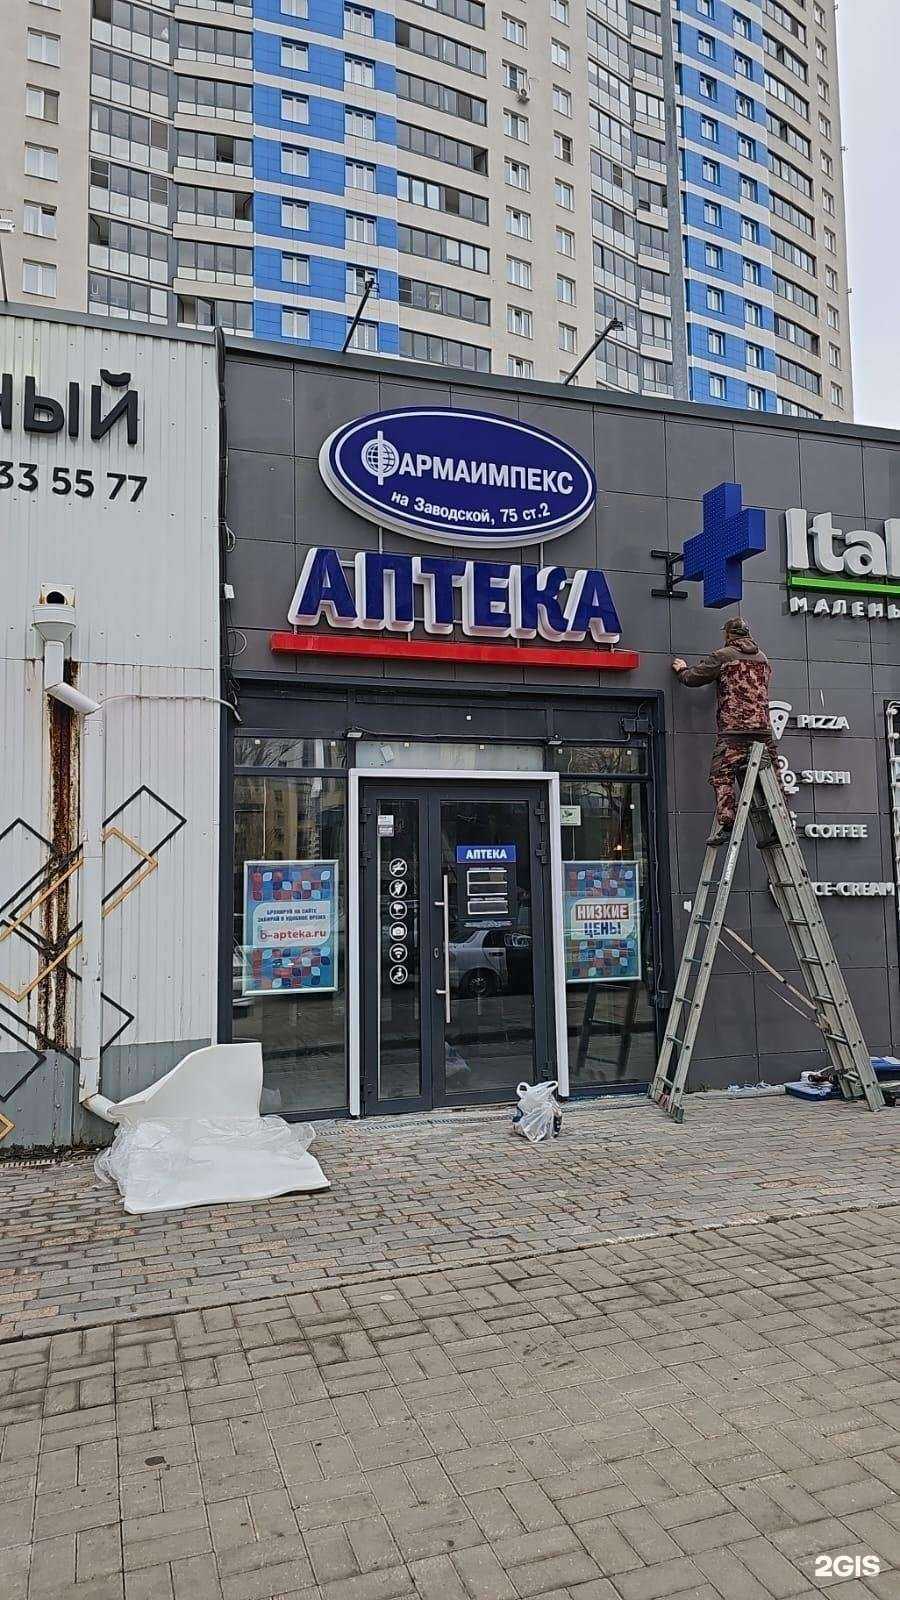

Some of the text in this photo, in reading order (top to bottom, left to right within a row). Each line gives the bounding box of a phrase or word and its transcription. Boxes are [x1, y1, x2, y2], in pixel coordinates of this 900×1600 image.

[361, 430, 574, 494] ФАРМАИМПЕКС
[52, 466, 95, 498] 55
[107, 472, 148, 502] 77
[391, 491, 551, 525] на Заводской, 75 ст.2
[288, 547, 623, 644] АПТЕКА
[797, 714, 850, 730] PIZZA
[801, 769, 851, 785] SUSHI
[804, 823, 868, 838] COFFEE
[466, 849, 507, 860] АПТЕКА
[810, 881, 895, 897] CE-CREAM
[577, 904, 629, 920] НИЗКИЕ
[260, 930, 327, 940] b-apteka.ru
[584, 921, 621, 938] ЦЕНЫ
